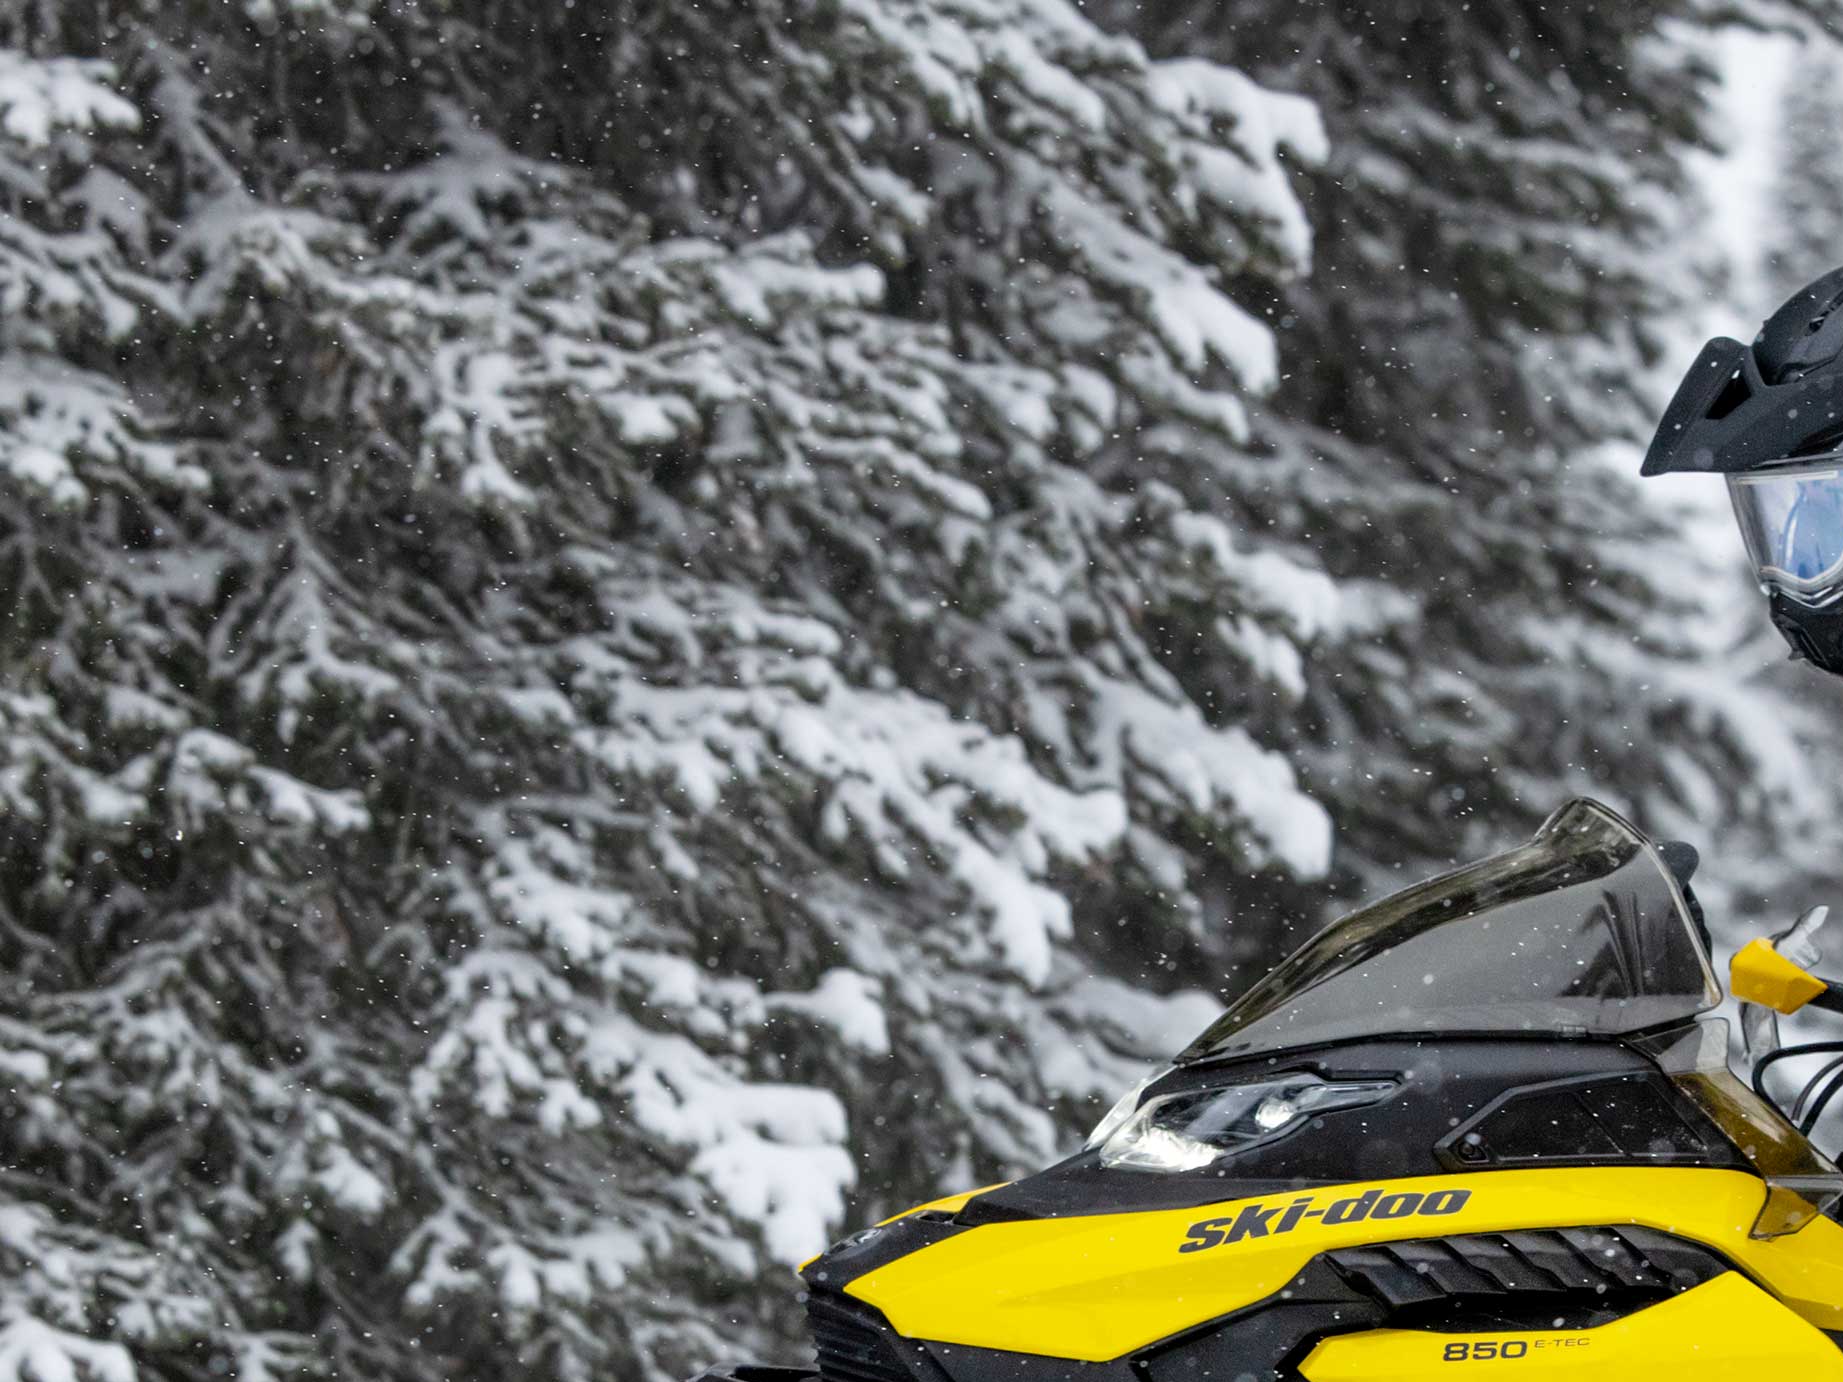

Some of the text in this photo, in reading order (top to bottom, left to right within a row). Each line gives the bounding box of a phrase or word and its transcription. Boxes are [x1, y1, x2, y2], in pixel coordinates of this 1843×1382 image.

[1179, 1189, 1472, 1254] ski-doo
[1443, 1338, 1590, 1361] 850 E-TEC
